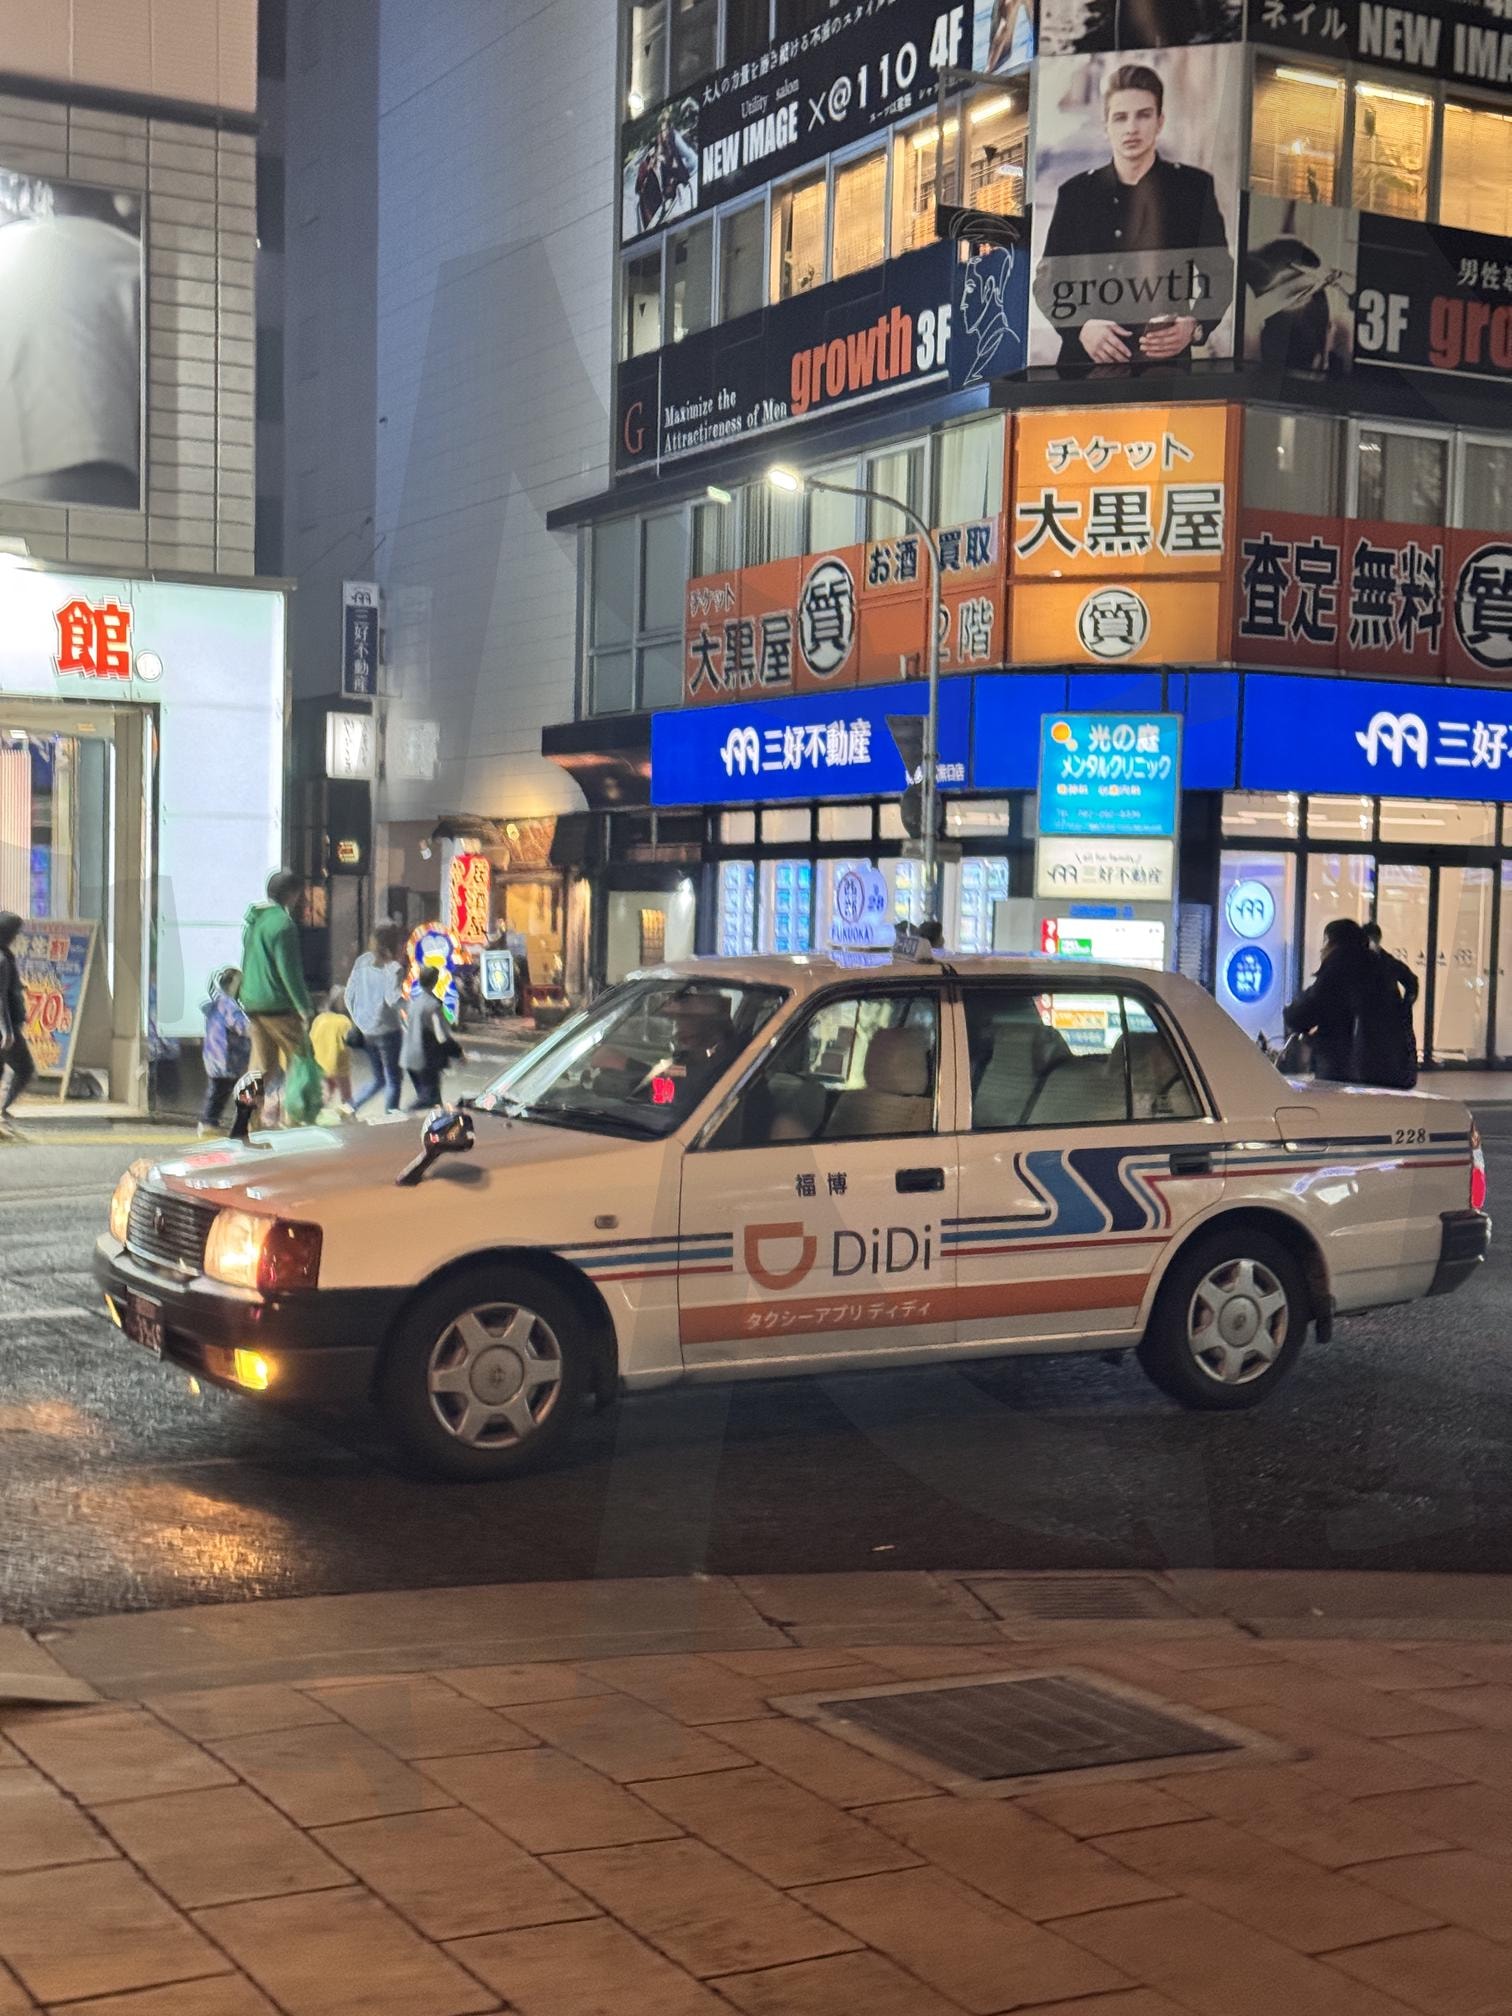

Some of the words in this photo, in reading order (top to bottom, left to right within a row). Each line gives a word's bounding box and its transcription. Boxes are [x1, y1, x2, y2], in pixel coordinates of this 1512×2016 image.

[1261, 0, 1348, 40] ネイル
[1358, 2, 1442, 68] NEW
[702, 135, 739, 185] NEW
[742, 102, 799, 170] IMAGE
[929, 5, 965, 70] 4F
[1050, 259, 1211, 320] growth
[1357, 288, 1410, 354] 3F
[789, 305, 912, 416] growth
[916, 304, 952, 372] 3F
[624, 400, 646, 455] G
[663, 396, 714, 429] Maximize
[717, 387, 737, 411] the
[746, 403, 760, 428] of
[761, 397, 788, 424] Men
[1046, 432, 1195, 473] チケット
[1015, 482, 1225, 560] 大黒屋
[866, 522, 993, 587] お酒買取
[803, 568, 853, 666] 質
[1238, 531, 1445, 656] 査定無料
[53, 598, 132, 679] 館
[351, 608, 371, 694] 三好不動産
[689, 608, 793, 697] 大黒屋
[1081, 593, 1144, 656] 質
[762, 719, 872, 772] 三好不動産
[1060, 754, 1172, 780] メンタルクリニック
[1087, 723, 1161, 753] 光の庭
[1434, 720, 1512, 770] 三好
[1395, 1127, 1427, 1145] 228
[795, 1171, 848, 1198] 福博
[832, 1224, 931, 1277] DiDi
[746, 1303, 862, 1330] タクシーアプリ
